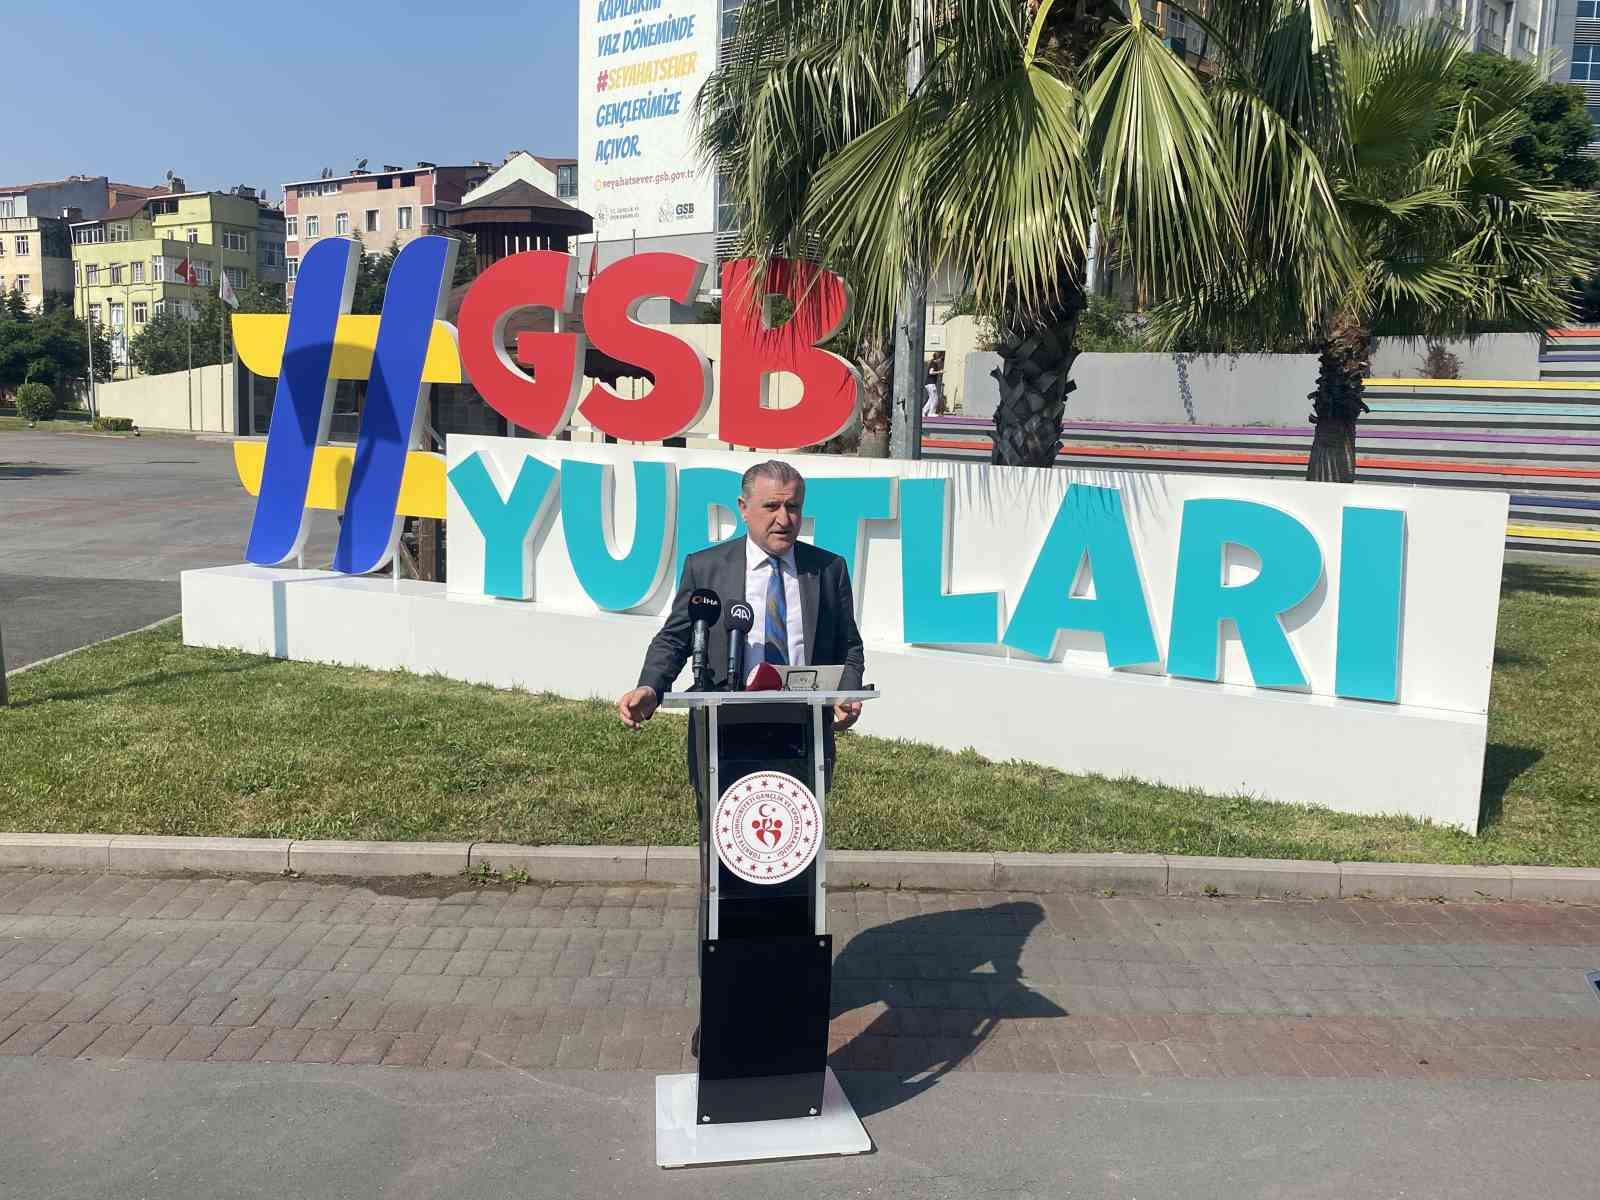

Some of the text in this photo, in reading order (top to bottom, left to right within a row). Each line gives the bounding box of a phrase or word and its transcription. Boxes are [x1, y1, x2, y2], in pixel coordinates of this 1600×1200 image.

[598, 14, 696, 57] YAZ DÖNEMİNDE
[597, 52, 697, 92] #SEYAHATSEVER
[597, 88, 682, 128] GENÇLERİMİZE
[595, 135, 641, 165] AÇIYOR.
[675, 203, 695, 215] GSB
[732, 606, 749, 620] AA
